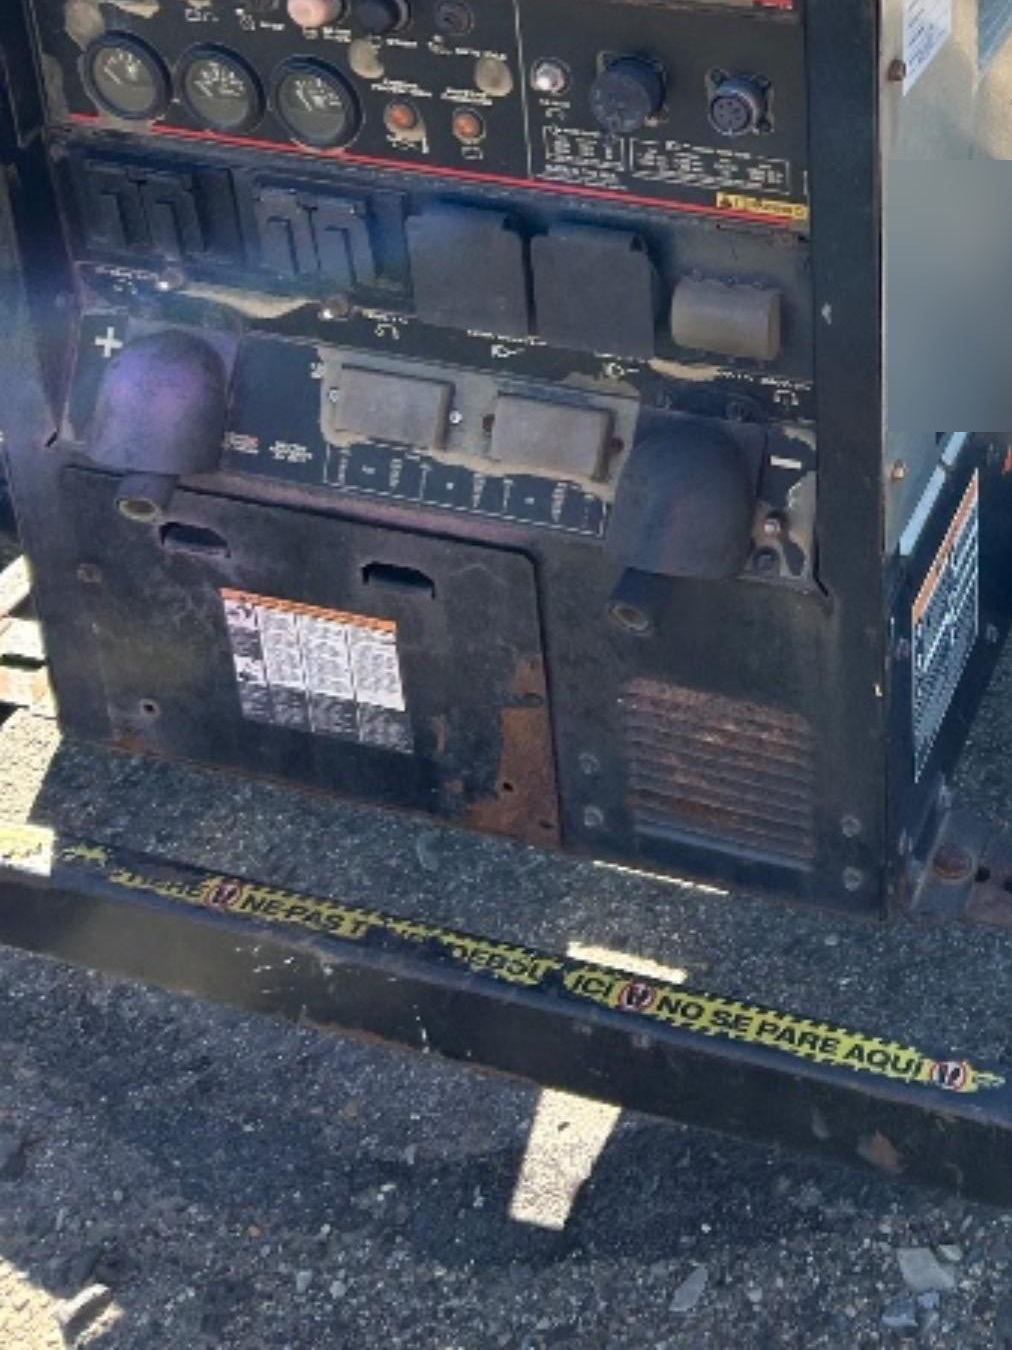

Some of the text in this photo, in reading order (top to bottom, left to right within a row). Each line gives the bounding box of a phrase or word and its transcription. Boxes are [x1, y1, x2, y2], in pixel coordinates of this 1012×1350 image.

[572, 974, 613, 998] ICI
[656, 995, 704, 1020] NO
[711, 1009, 753, 1033] SE
[755, 1020, 841, 1053] PARE
